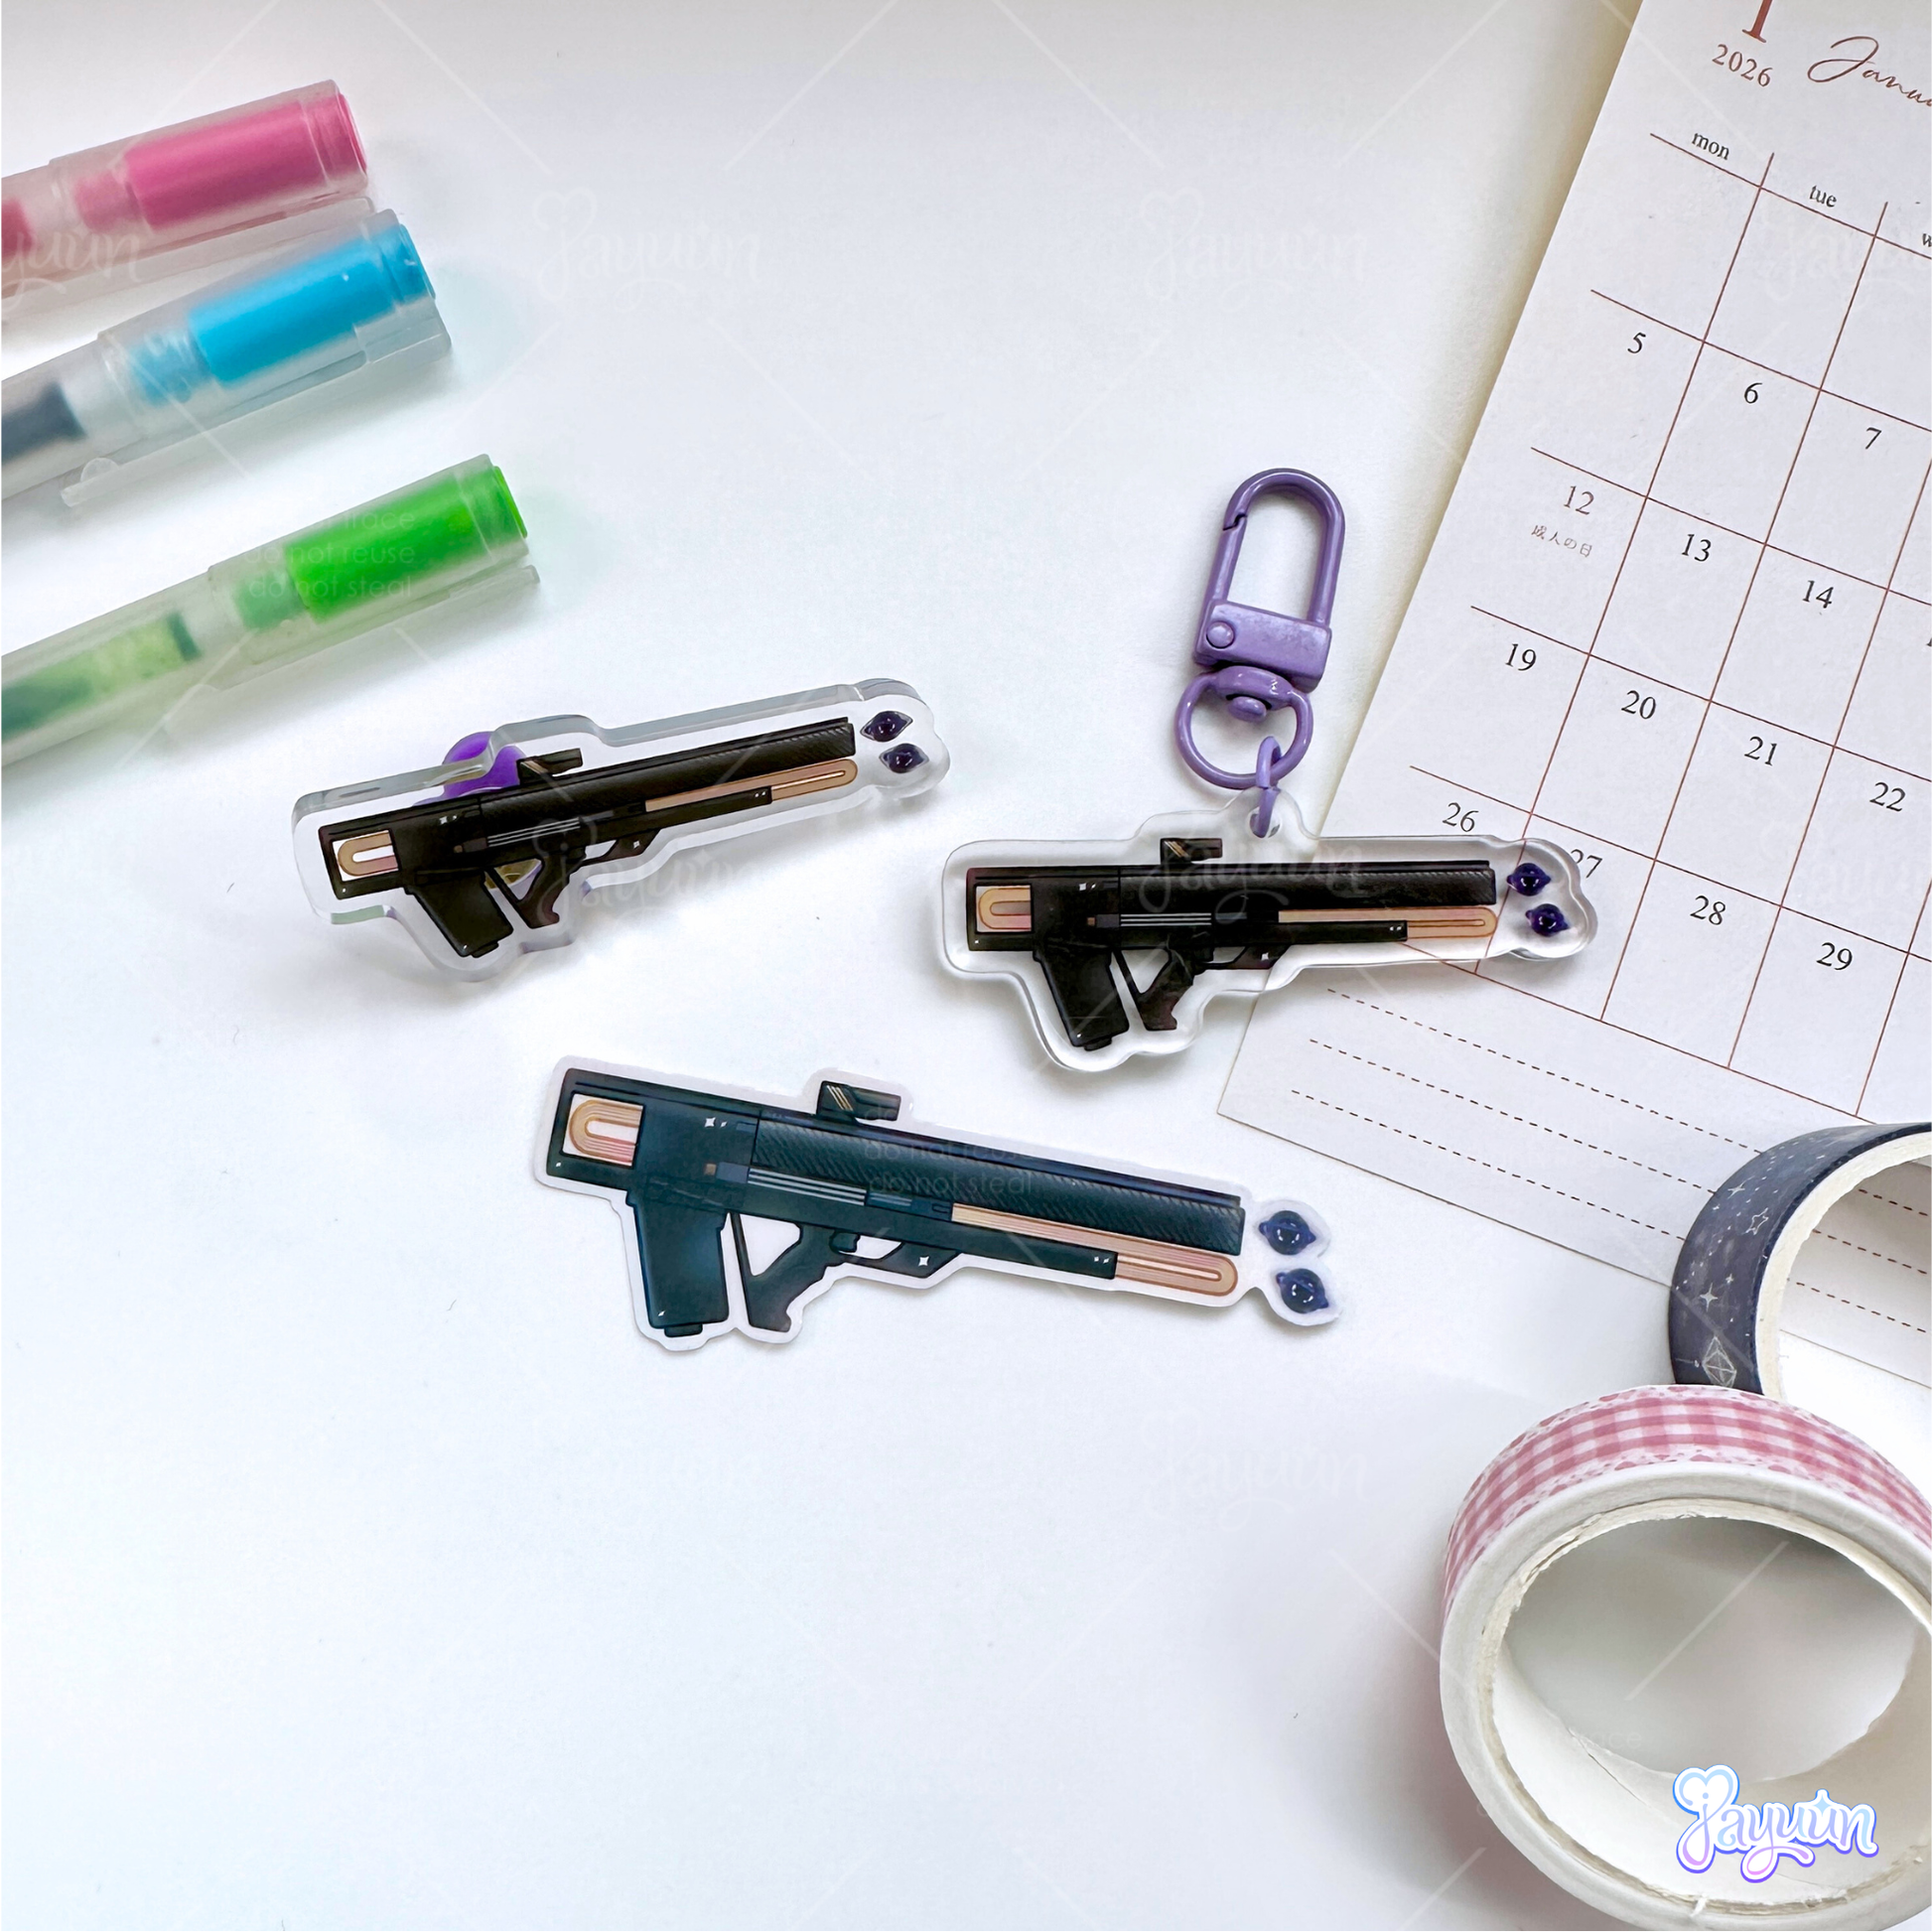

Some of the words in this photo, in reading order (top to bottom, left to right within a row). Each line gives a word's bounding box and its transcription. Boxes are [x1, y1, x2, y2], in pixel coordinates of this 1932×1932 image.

[1712, 43, 1774, 87] 2026
[1691, 132, 1730, 161] mon
[1809, 185, 1837, 207] tue
[1626, 332, 1647, 354] 5
[1743, 381, 1763, 405] 6
[1864, 427, 1882, 451] 7
[1563, 484, 1594, 516] 12
[1530, 524, 1593, 558] 成人の日
[1681, 533, 1713, 563] 13
[1801, 579, 1835, 610] 14
[1504, 642, 1538, 672] 19
[1620, 689, 1657, 721] 20
[1743, 735, 1778, 766] 21
[1868, 781, 1906, 813] 22
[1442, 801, 1479, 833] 26
[1689, 895, 1726, 925] 28
[1815, 941, 1854, 971] 29
